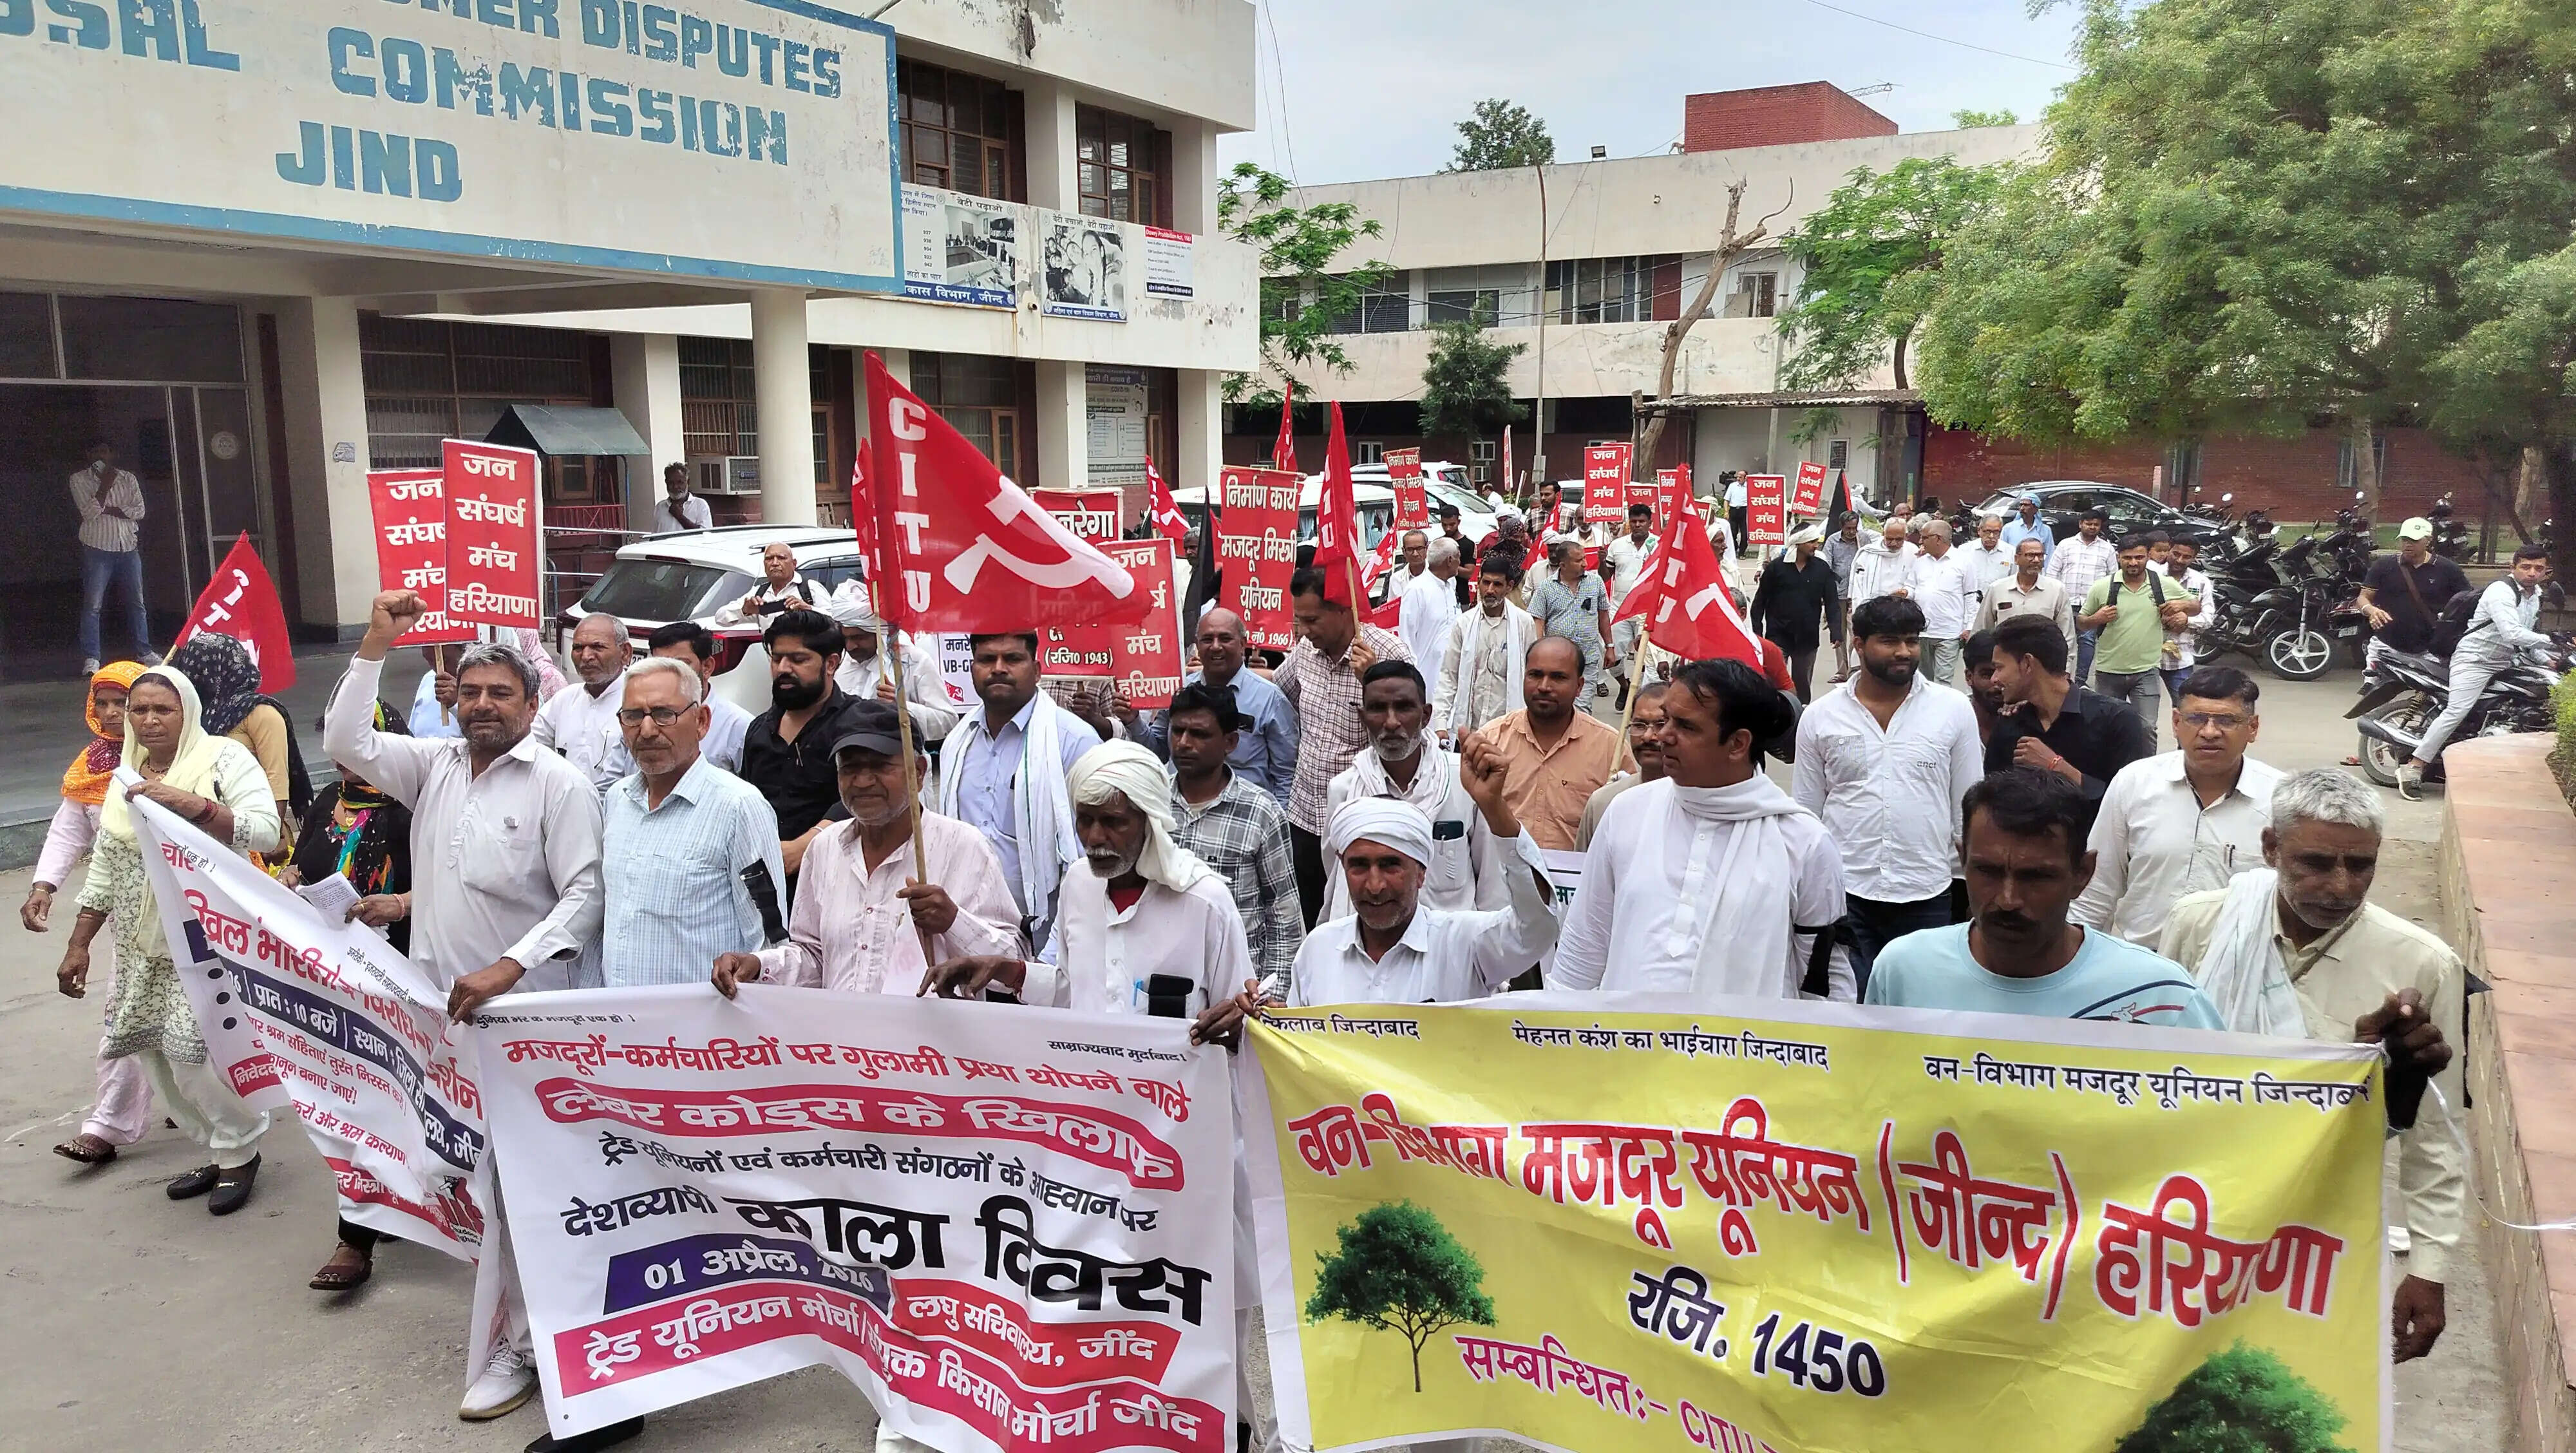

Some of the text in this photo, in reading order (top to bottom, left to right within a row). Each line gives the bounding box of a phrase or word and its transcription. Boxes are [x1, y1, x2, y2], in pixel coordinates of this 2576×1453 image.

[582, 0, 841, 98] DISPUTES
[328, 26, 788, 166] COMMISSION
[276, 121, 462, 203] JIND
[956, 196, 973, 207] बेटी
[1052, 213, 1063, 222] बेटी
[935, 285, 1003, 305] विभाग, जीन्द
[460, 452, 517, 481] जन
[1592, 450, 1617, 461] जन
[1805, 464, 1822, 475] जन
[1588, 465, 1620, 480] संघर्ष
[1753, 479, 1777, 489] जन
[1799, 475, 1821, 488] संघर्ष
[386, 478, 444, 500] जन
[1226, 474, 1298, 512] निर्माण कार्य
[1593, 486, 1615, 499] मंच
[1631, 488, 1653, 497] जन
[1750, 493, 1781, 507] संघर्ष
[1799, 489, 1815, 501] मंच
[455, 493, 526, 528] संघर्ष
[888, 397, 931, 613] CITU
[1585, 503, 1622, 519] हरियाणा
[1755, 512, 1777, 524] मंच
[1792, 500, 1817, 515] हरियाणा
[1748, 528, 1784, 542] हरियाणा
[468, 541, 518, 572] मंच
[1111, 547, 1157, 569] जन
[1220, 526, 1298, 573] मजदूर मिस्त्री
[448, 582, 537, 618] हरियाणा
[1239, 576, 1283, 622] यूनियन
[944, 634, 971, 652] मनरे
[1124, 628, 1162, 656] मंच
[1267, 629, 1294, 648] 1966)
[1084, 647, 1114, 670] 1943)
[293, 1002, 307, 1025] 10
[309, 1007, 338, 1038] बजे
[477, 1014, 510, 1029] दुनिया
[1329, 1013, 1421, 1040] जिन्दाबाद
[1046, 1040, 1126, 1059] साम्राज्यवाद
[1511, 1019, 1828, 1070] मेहनत कंश का भाईचारा जिन्दाबाद
[267, 1024, 285, 1043] श्रम
[328, 1054, 355, 1078] तुरंत
[356, 1063, 391, 1096] निरस्त
[502, 1033, 1193, 1124] मजदूरों-कर्मचारियों पर गुलामी प्रथा थोपने वाले
[1922, 1052, 2056, 1090] वन-विभाग
[2061, 1066, 2141, 1108] मजदूर
[2146, 1066, 2244, 1110] यूनियन
[315, 1108, 340, 1133] और
[339, 1121, 366, 1142] श्रम
[545, 1081, 665, 1127] लेबर
[877, 1096, 947, 1128] के
[961, 1098, 1175, 1179] खिलाफ
[598, 1130, 638, 1168] ट्रेड
[638, 1139, 726, 1174] यूनियनों
[728, 1146, 775, 1170] एवं
[776, 1141, 888, 1171] कर्मचारी
[893, 1149, 996, 1184] संगठनों
[998, 1156, 1027, 1188] के
[1121, 1203, 1160, 1233] पर
[1288, 1092, 1514, 1188] वन-विभाग
[1520, 1123, 1683, 1251] मजदूर
[1681, 1096, 1870, 1257] यूनियन
[2094, 1175, 2344, 1327] हरियाणा
[559, 1184, 719, 1237] देशव्यापी
[720, 1194, 952, 1271] काला
[644, 1258, 687, 1291] 01
[701, 1239, 810, 1277] अप्रैल,
[905, 1295, 960, 1331] लघु
[1076, 1328, 1158, 1361] जींद
[1628, 1266, 1886, 1398] रजि. 1450
[582, 1295, 1203, 1443] ट्रेड यूनियन किसान मोर्चा जींद
